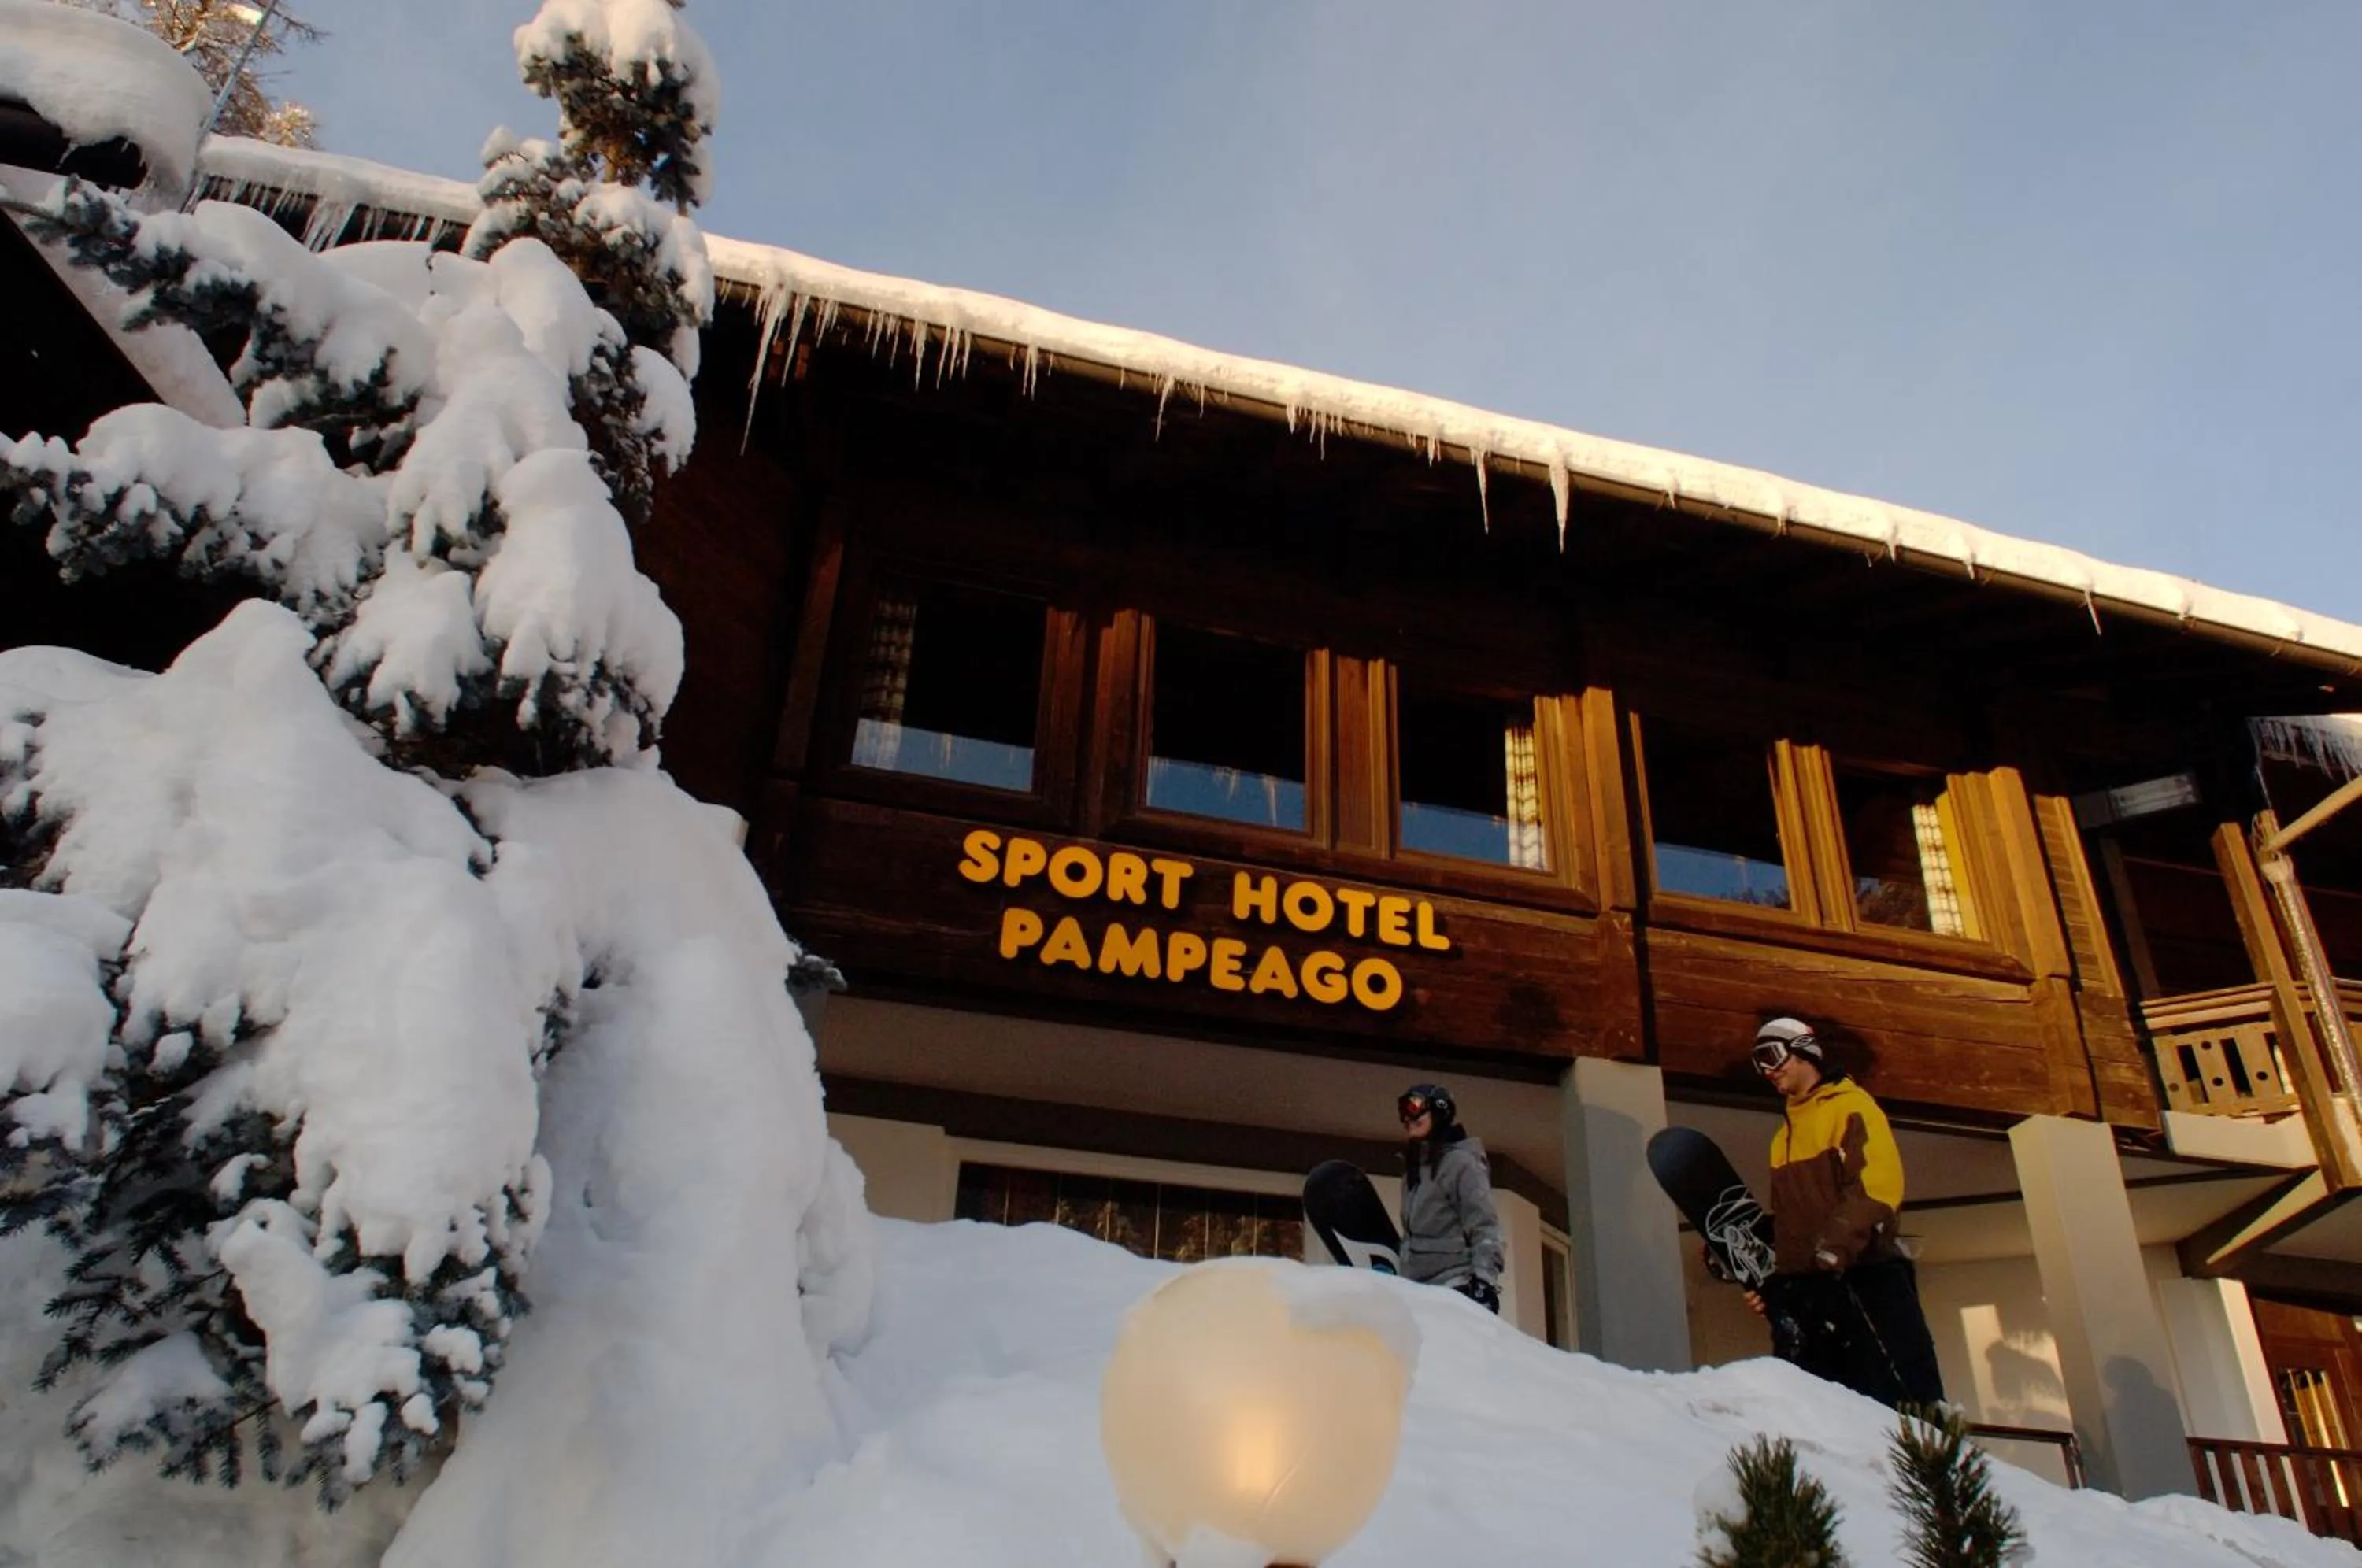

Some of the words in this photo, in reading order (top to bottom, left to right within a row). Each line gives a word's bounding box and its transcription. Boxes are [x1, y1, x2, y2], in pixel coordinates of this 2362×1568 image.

[958, 830, 1194, 909] SPORT
[1232, 871, 1451, 951] HOTEL
[1000, 908, 1403, 1011] PAMPEAGO
